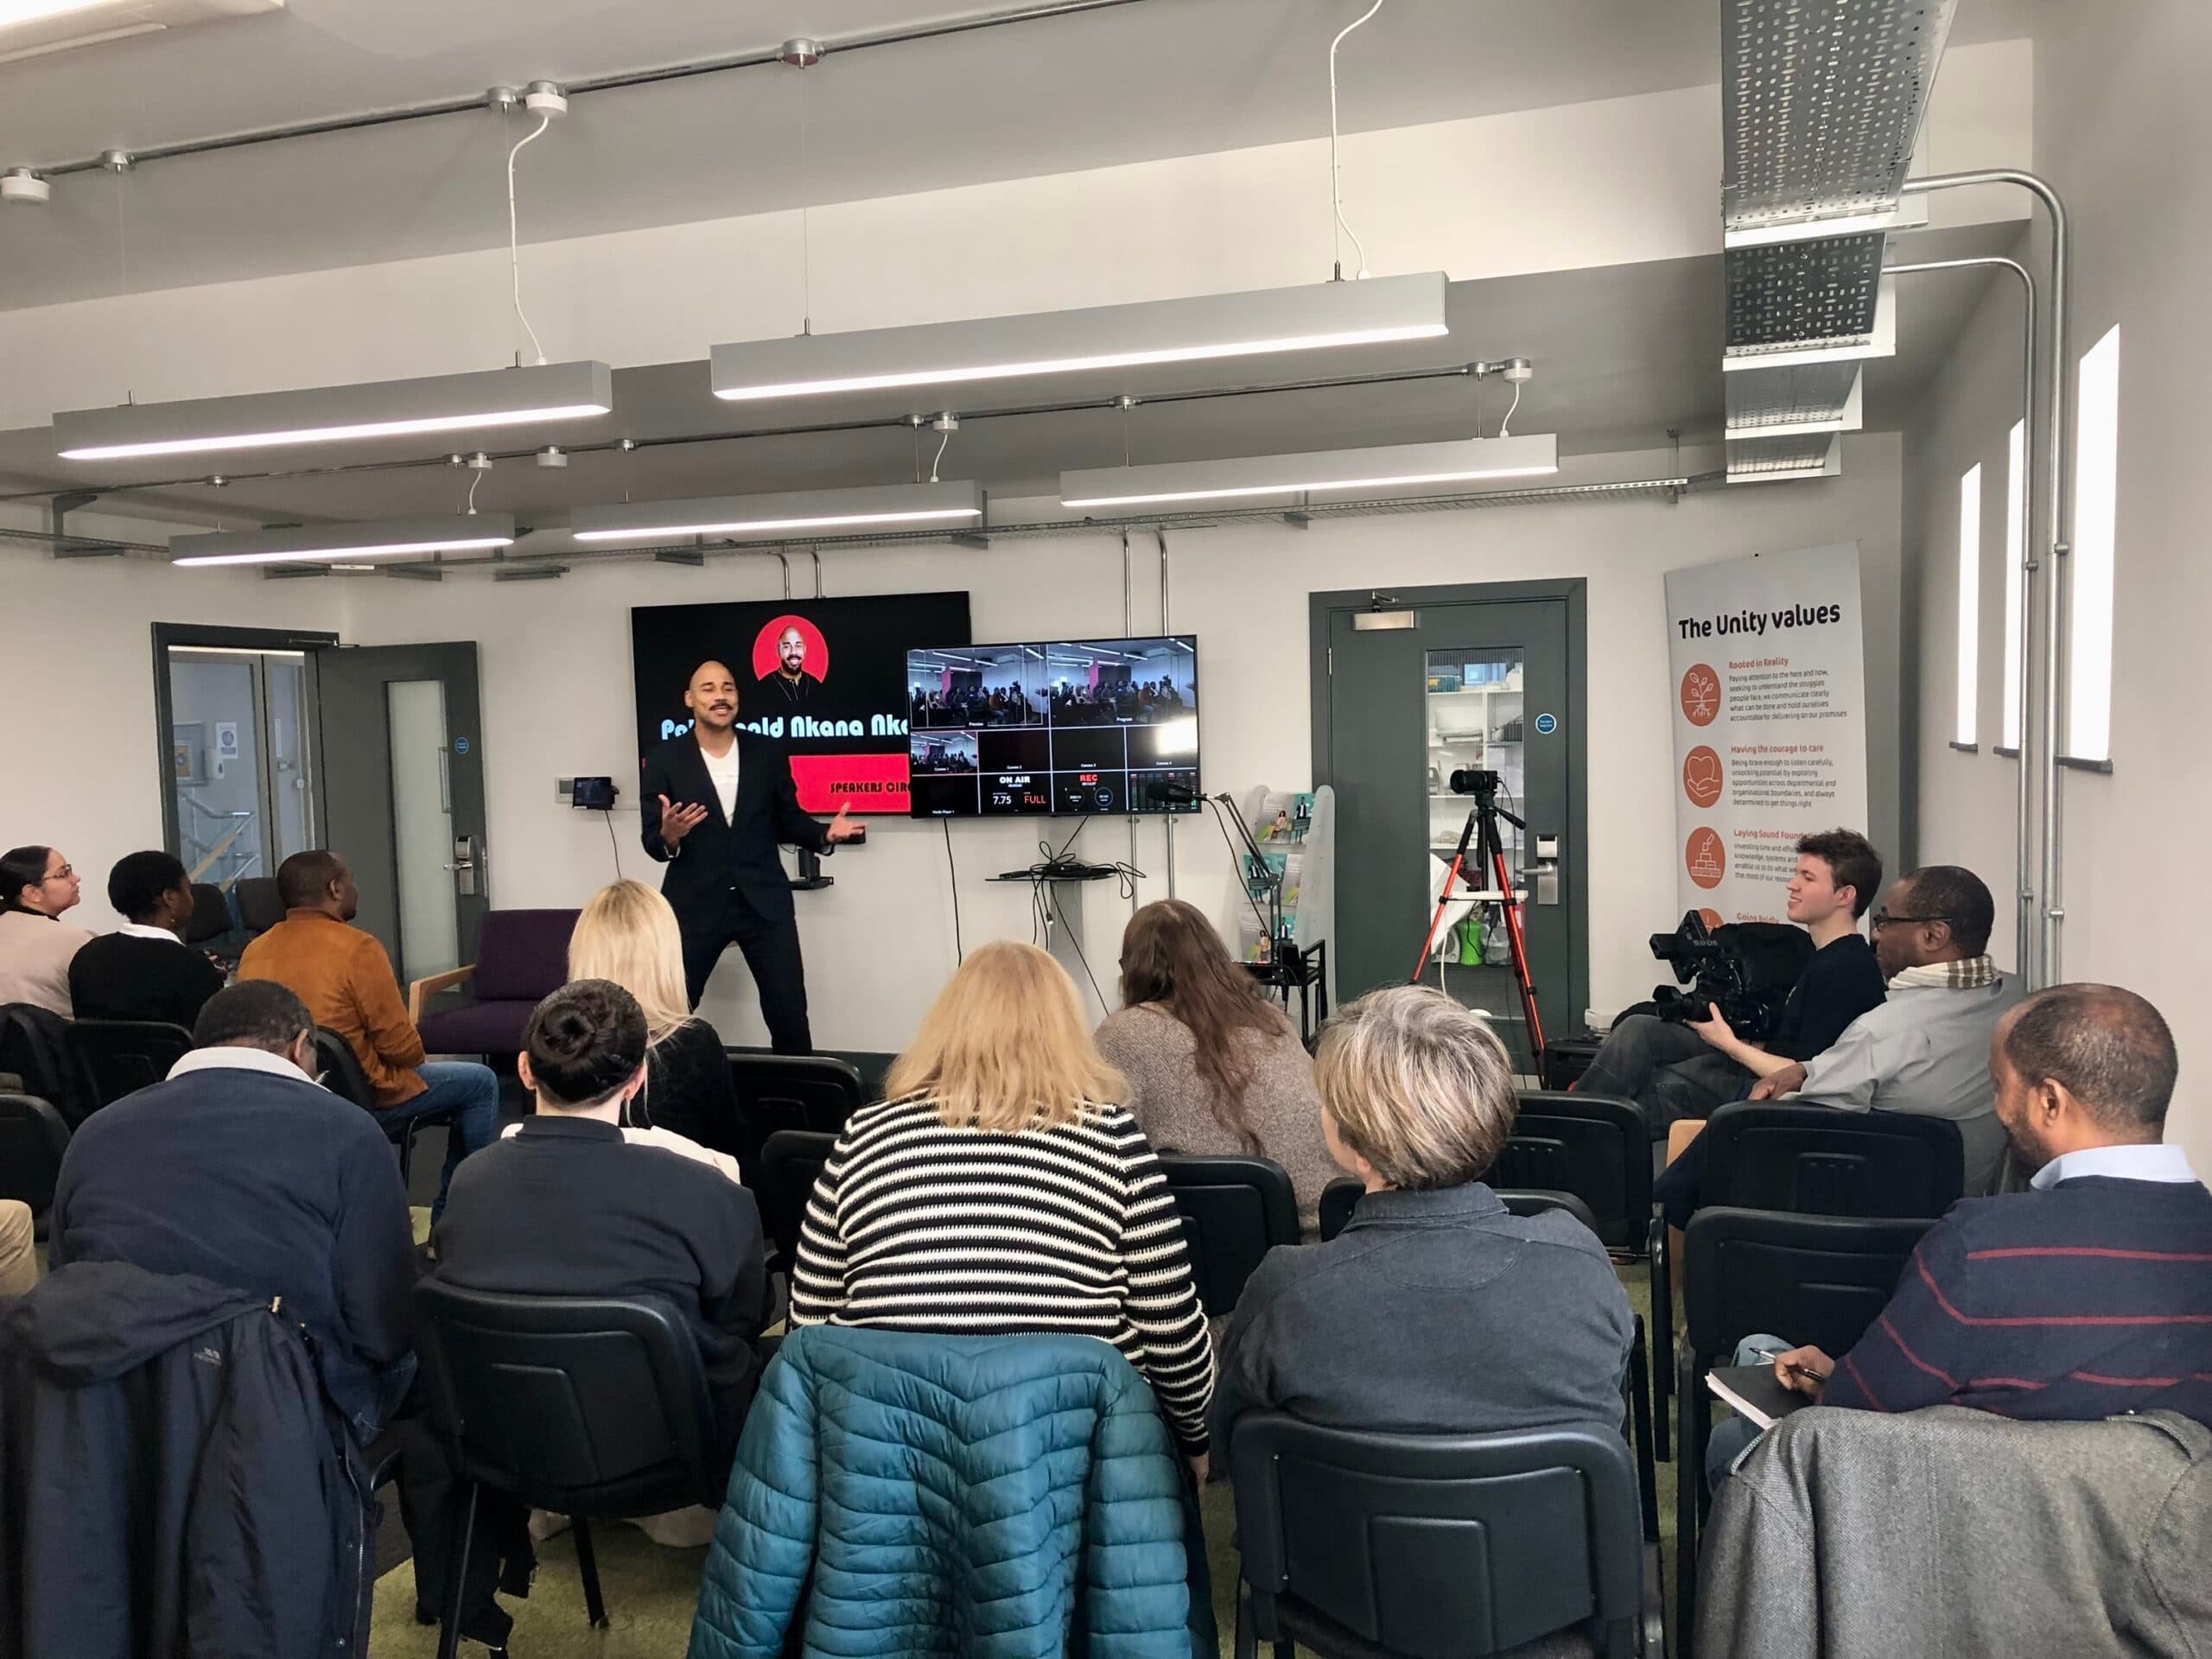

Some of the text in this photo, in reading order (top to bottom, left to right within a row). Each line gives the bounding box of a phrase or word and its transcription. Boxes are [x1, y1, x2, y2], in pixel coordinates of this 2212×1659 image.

[1679, 604, 1840, 639] The Unity values
[1729, 660, 1754, 669] Rooted
[1764, 658, 1789, 666] Reality
[791, 715, 864, 737] Nkana
[1732, 746, 1756, 754] Having
[1770, 745, 1797, 753] courage
[830, 782, 882, 793] SPEAKERS
[993, 796, 1012, 804] 7.75
[1024, 795, 1046, 804] FULL
[1734, 830, 1758, 838] Laying
[1758, 830, 1779, 838] Sound
